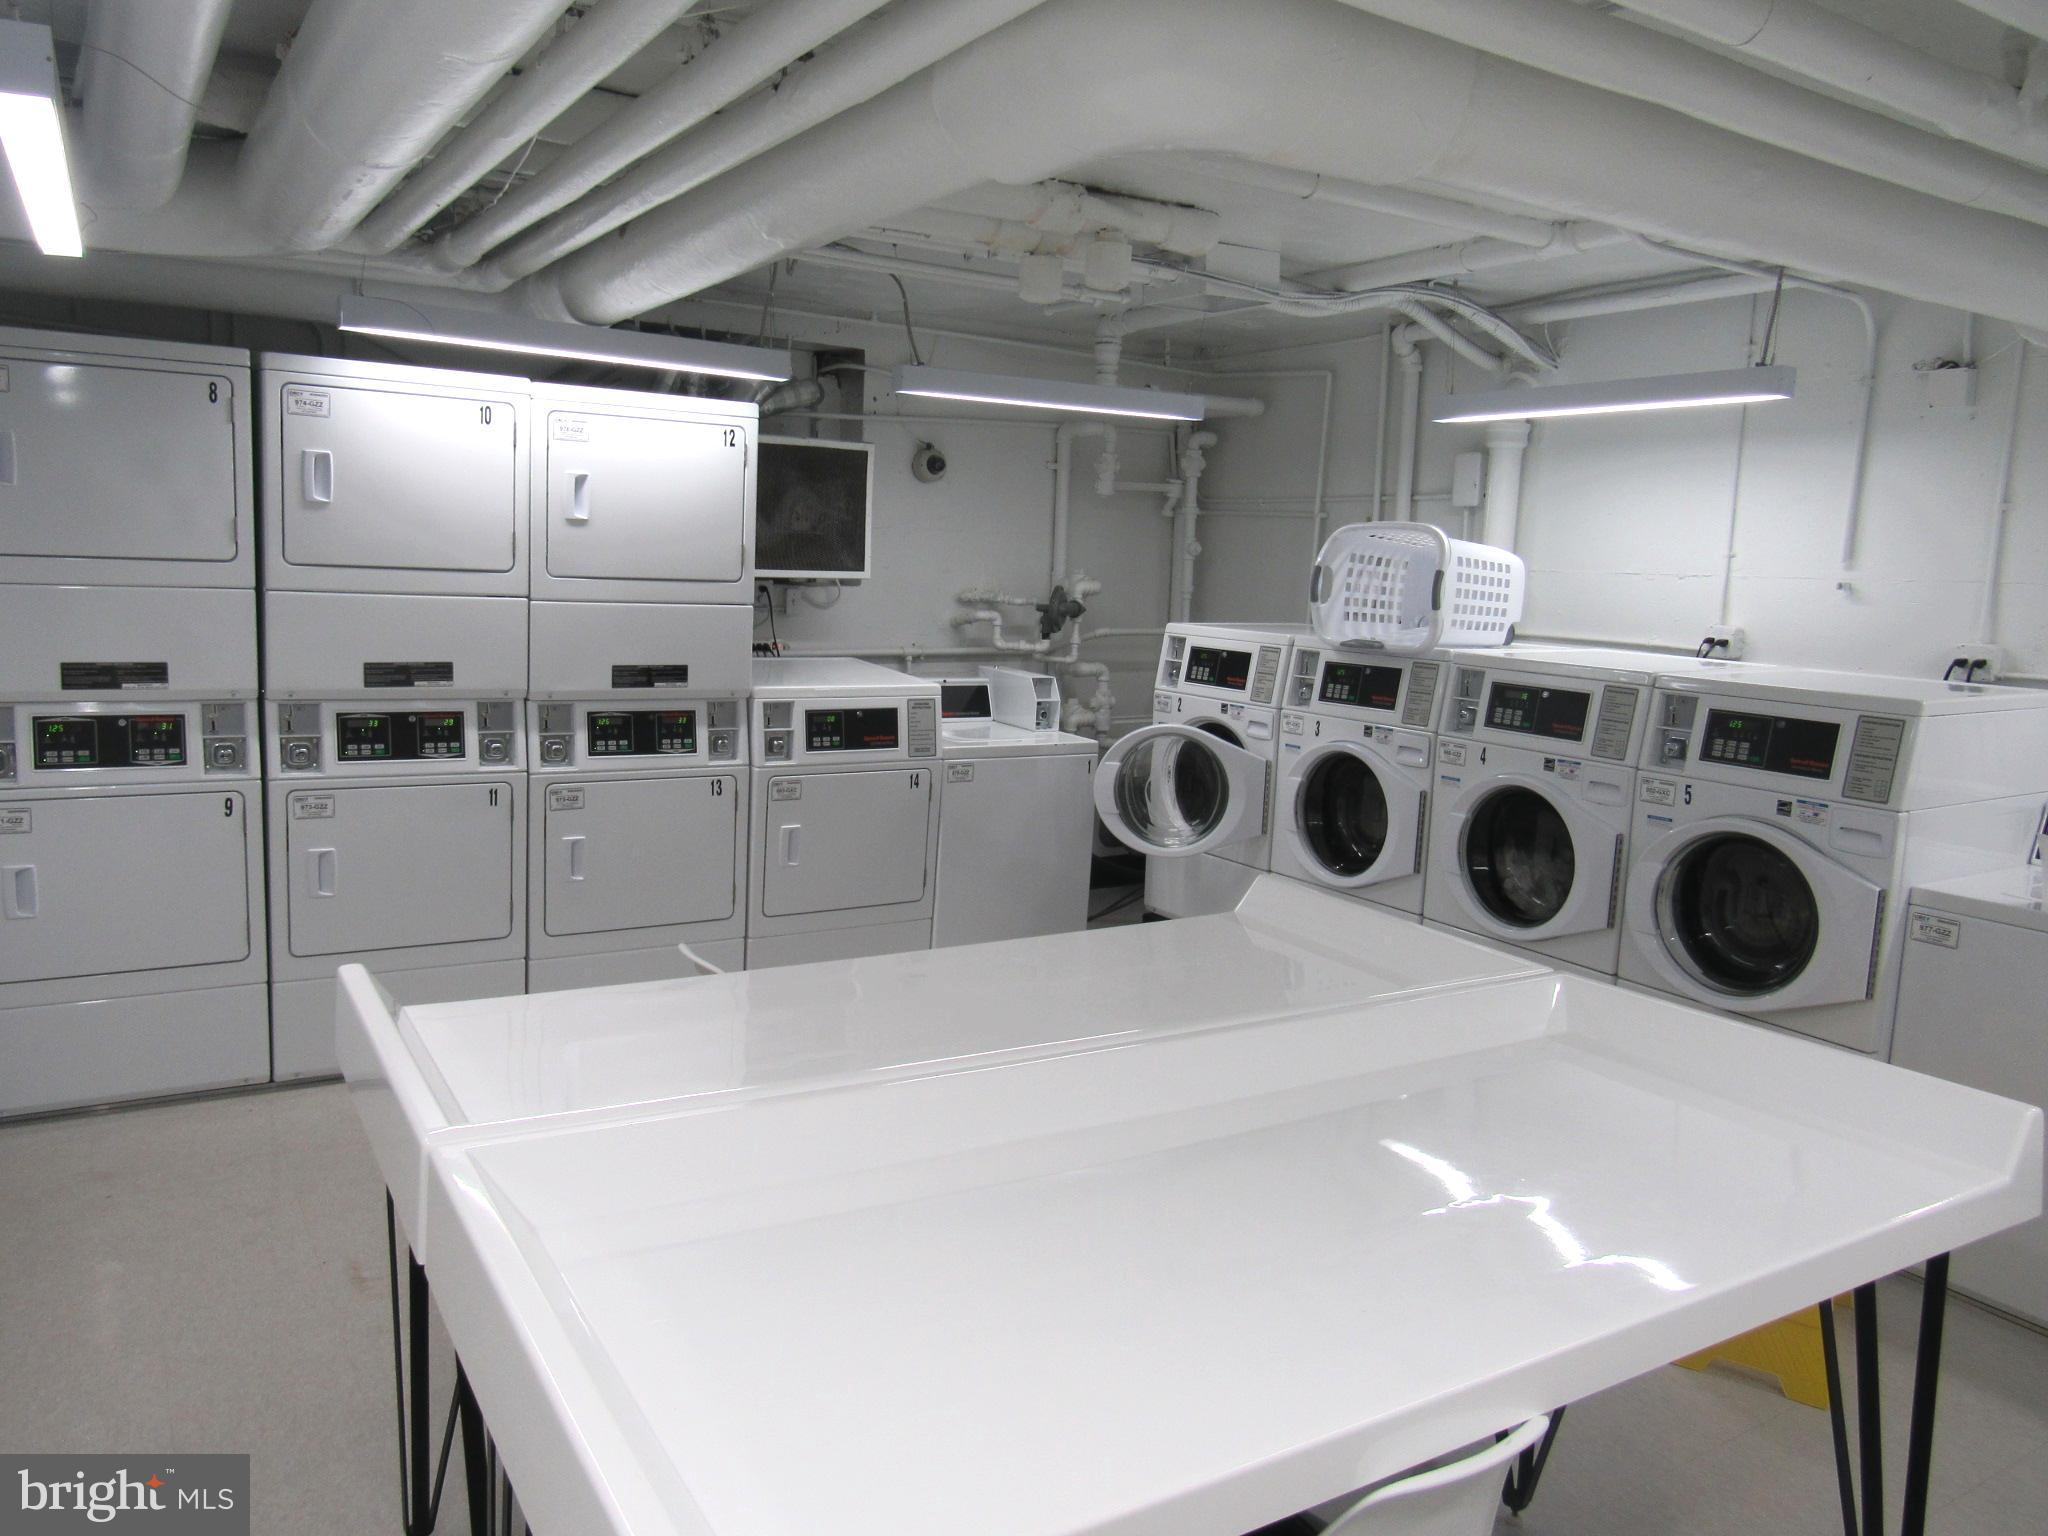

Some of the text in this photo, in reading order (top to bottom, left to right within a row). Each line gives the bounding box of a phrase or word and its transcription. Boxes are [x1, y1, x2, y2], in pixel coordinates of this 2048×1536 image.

[209, 382, 217, 403] 8
[480, 406, 491, 425] 10
[724, 429, 736, 447] 12
[1177, 697, 1182, 712] 2
[1315, 720, 1321, 736] 3
[1480, 747, 1487, 765] 4
[711, 779, 722, 796] 13
[910, 773, 919, 789] 14
[489, 788, 498, 806] 11
[1684, 784, 1692, 805] 5
[224, 797, 233, 817] 9
